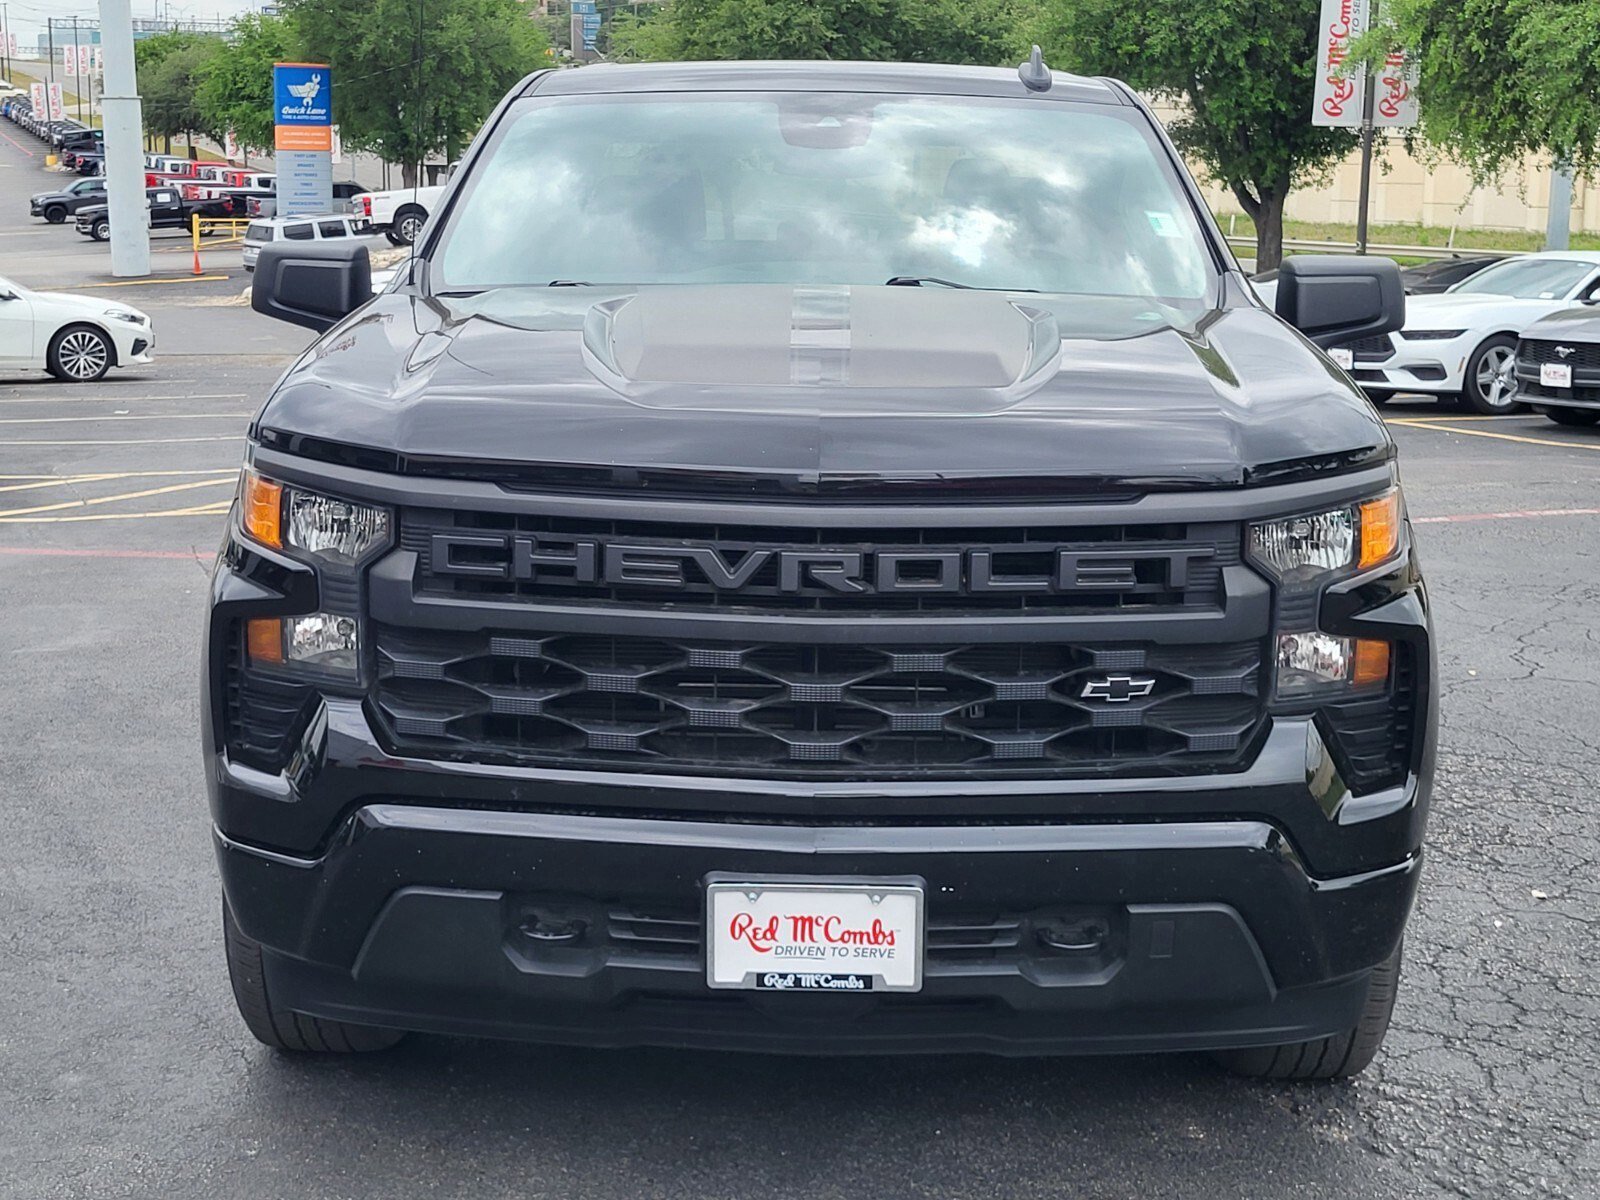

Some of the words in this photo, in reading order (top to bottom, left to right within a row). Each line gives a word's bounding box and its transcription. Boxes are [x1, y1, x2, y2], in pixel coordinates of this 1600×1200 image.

[281, 106, 306, 115] Quick
[306, 107, 327, 115] Lane
[1322, 76, 1353, 117] Red
[1378, 77, 1408, 118] Red
[430, 533, 1216, 596] CHEVROLET
[730, 912, 779, 953] Red
[783, 914, 896, 946] McCombs
[774, 946, 826, 957] DRIVEN
[830, 947, 849, 957] TO
[853, 948, 896, 959] SERVE
[763, 973, 795, 988] Red
[796, 974, 865, 989] McCombs
